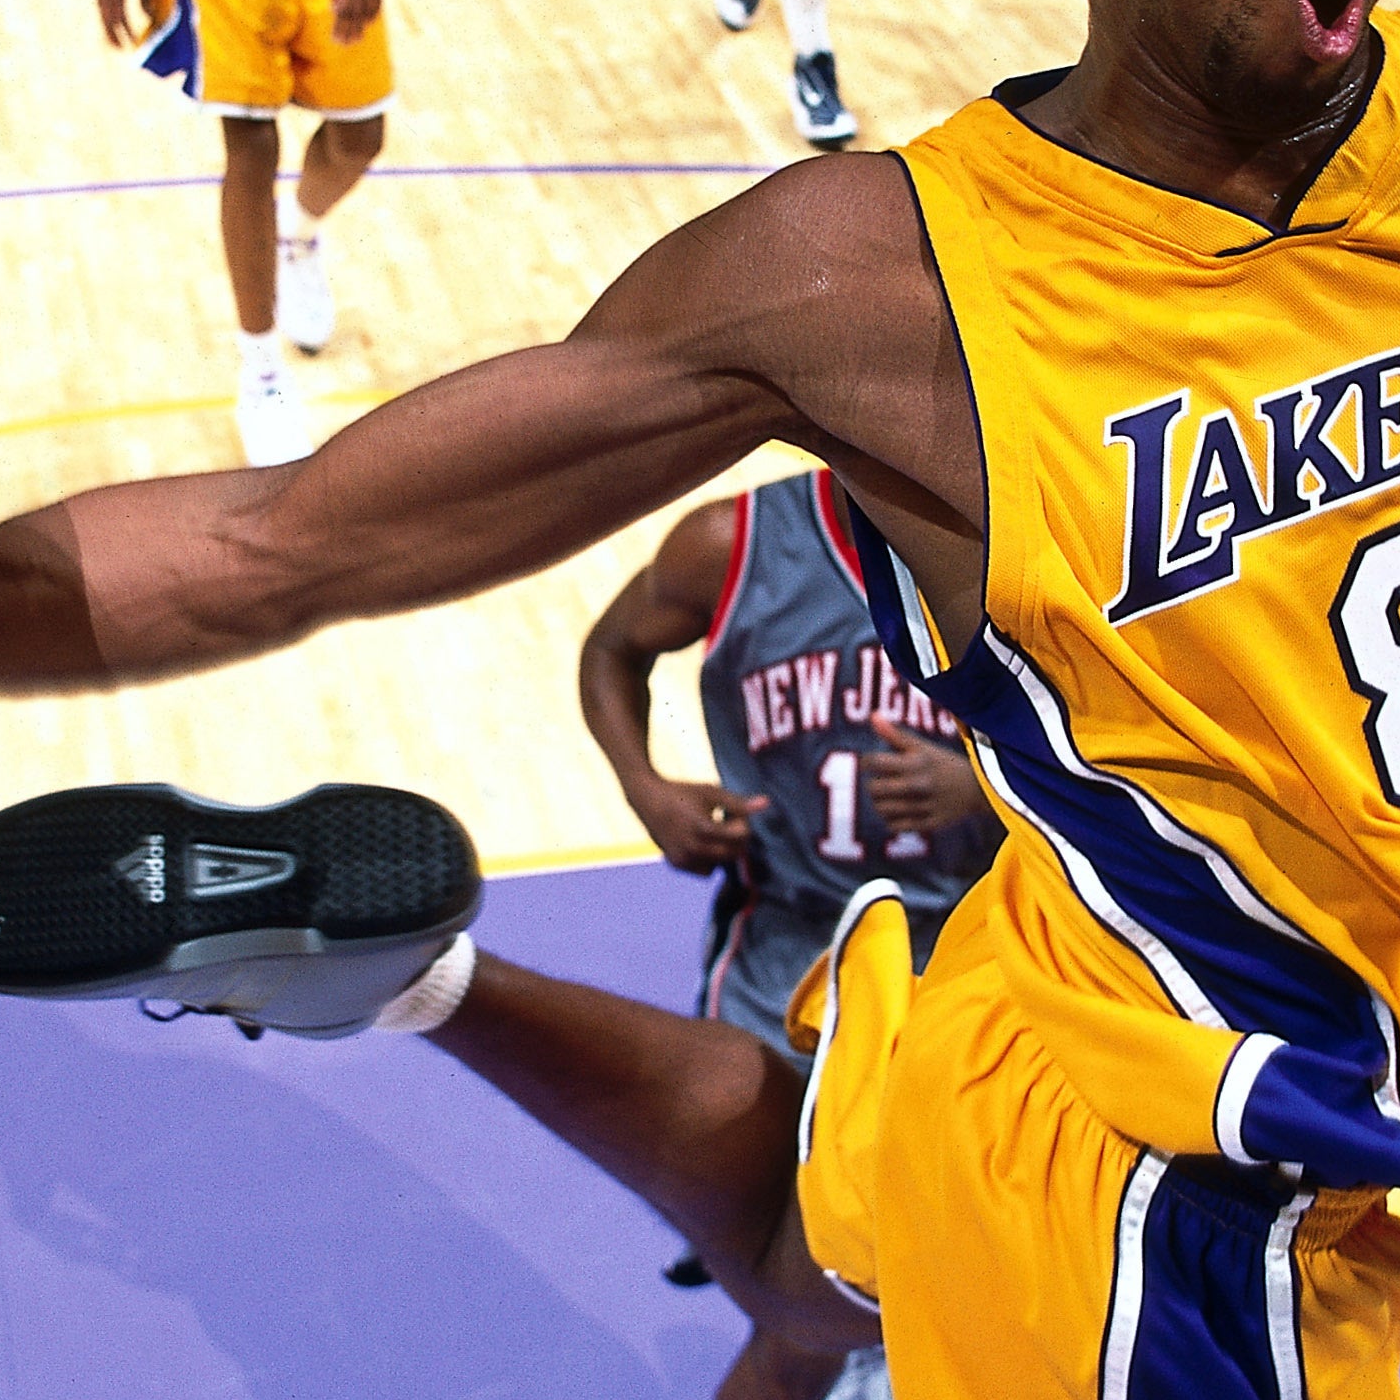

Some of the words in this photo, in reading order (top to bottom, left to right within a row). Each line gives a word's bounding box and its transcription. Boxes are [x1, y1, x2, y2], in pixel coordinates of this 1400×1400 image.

[741, 650, 839, 754] NEW
[843, 646, 958, 738] JER
[817, 750, 940, 860] 1
[145, 834, 166, 903] adidas
